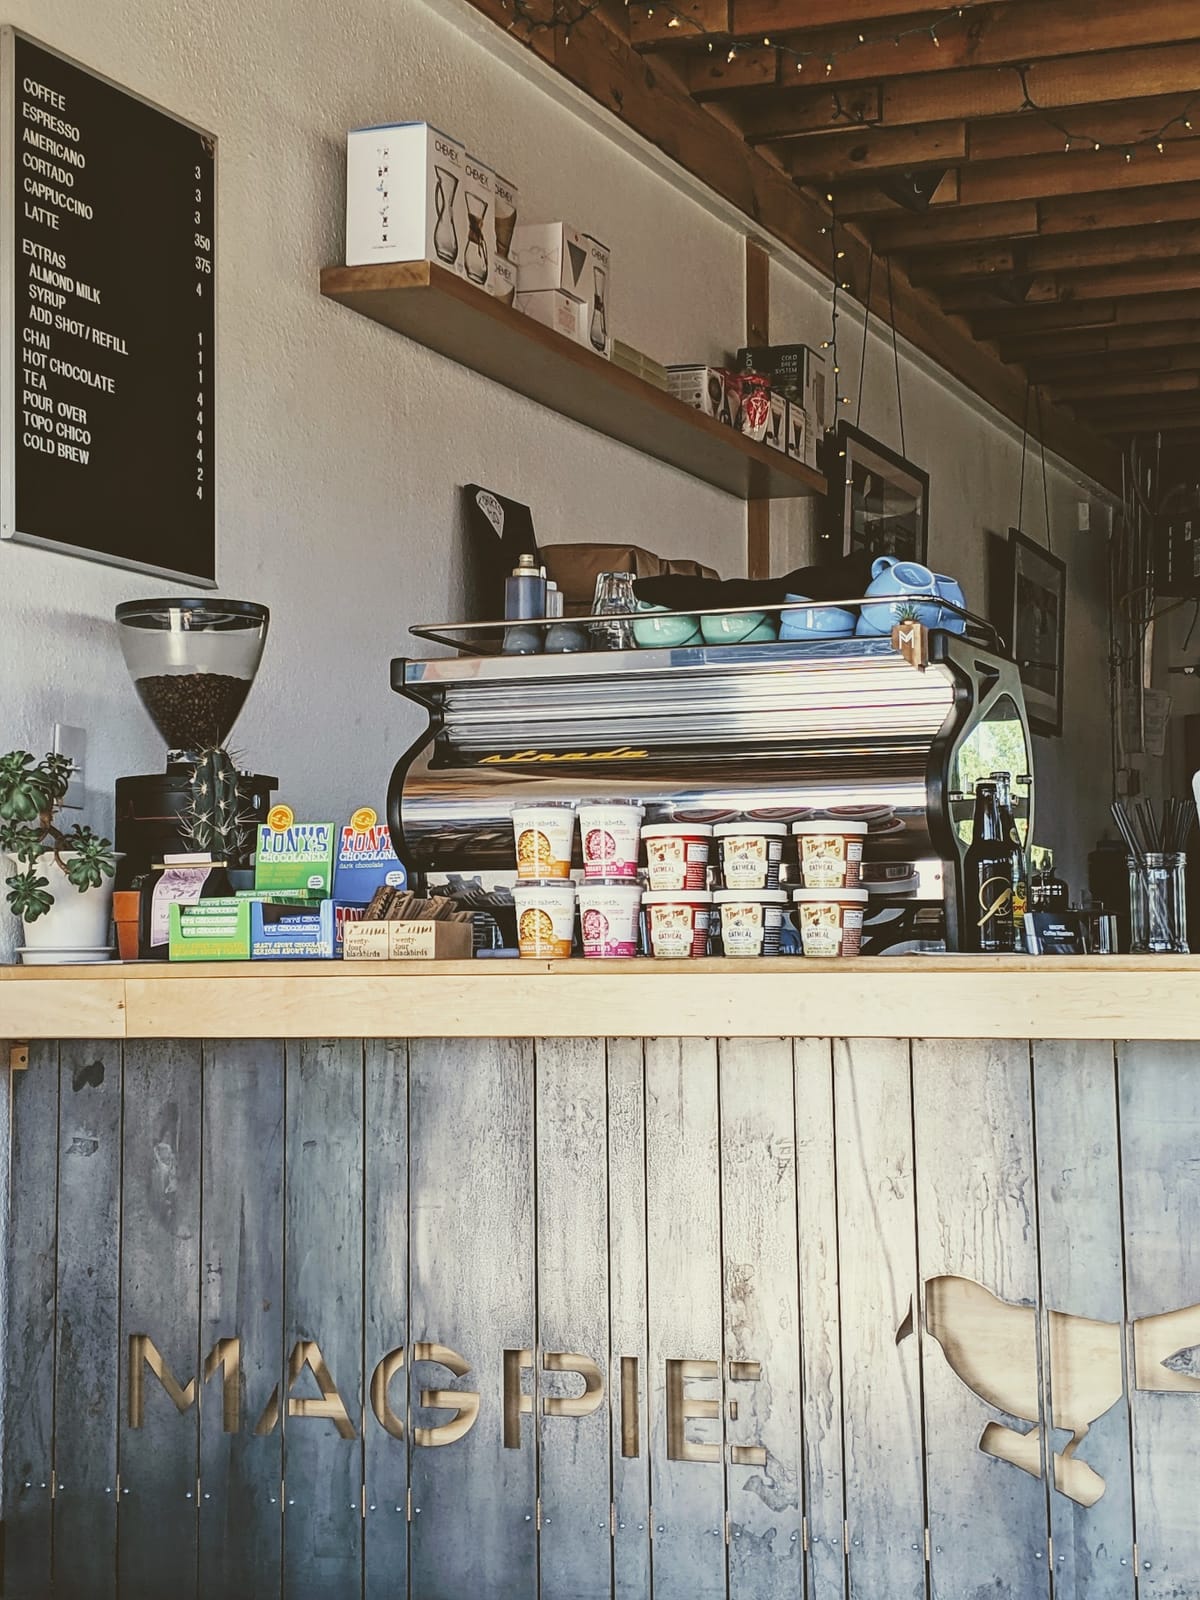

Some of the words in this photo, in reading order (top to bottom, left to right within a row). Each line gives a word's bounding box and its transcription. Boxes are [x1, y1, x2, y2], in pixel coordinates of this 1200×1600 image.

[23, 78, 65, 111] COFFEE
[195, 166, 200, 180] 3
[23, 102, 80, 142] ESPRESSO
[195, 189, 201, 202] 3
[435, 141, 458, 161] CHEMEX
[23, 128, 86, 168] AMERICANO
[194, 211, 200, 224] 3
[23, 153, 74, 187] CORTADO
[194, 233, 210, 252] 350
[465, 166, 489, 187] CHEMEX
[23, 238, 66, 269] EXTRAS
[24, 178, 93, 220] CAPPUCCINO
[195, 256, 211, 274] 375
[24, 202, 60, 230] LATTE
[196, 282, 202, 296] 4
[29, 263, 74, 292] ALMOND
[77, 281, 101, 304] MILK
[198, 332, 202, 346] 1
[29, 284, 66, 310] SYRUP
[198, 351, 202, 364] 1
[23, 328, 50, 350] CHAI
[197, 392, 203, 406] 4
[29, 305, 52, 326] ADD
[54, 314, 84, 339] SHOT
[92, 328, 128, 356] REFILL
[198, 370, 202, 384] 1
[782, 354, 798, 362] COLD
[23, 347, 47, 369] HOT
[50, 358, 115, 394] CHOCOLATE
[197, 411, 203, 425] 4
[23, 368, 47, 391] TEA
[197, 430, 203, 444] 4
[23, 390, 53, 414] POUR
[58, 402, 87, 425] OVER
[196, 449, 202, 463] 4
[23, 410, 53, 433] TOPO
[56, 422, 92, 445] CHICO
[198, 468, 204, 481] 2
[23, 432, 54, 454] COLD
[58, 442, 90, 465] BREW
[196, 486, 202, 500] 4
[478, 747, 648, 763] strada
[346, 950, 380, 958] blackbirds
[128, 1333, 767, 1464] MAGPIE
